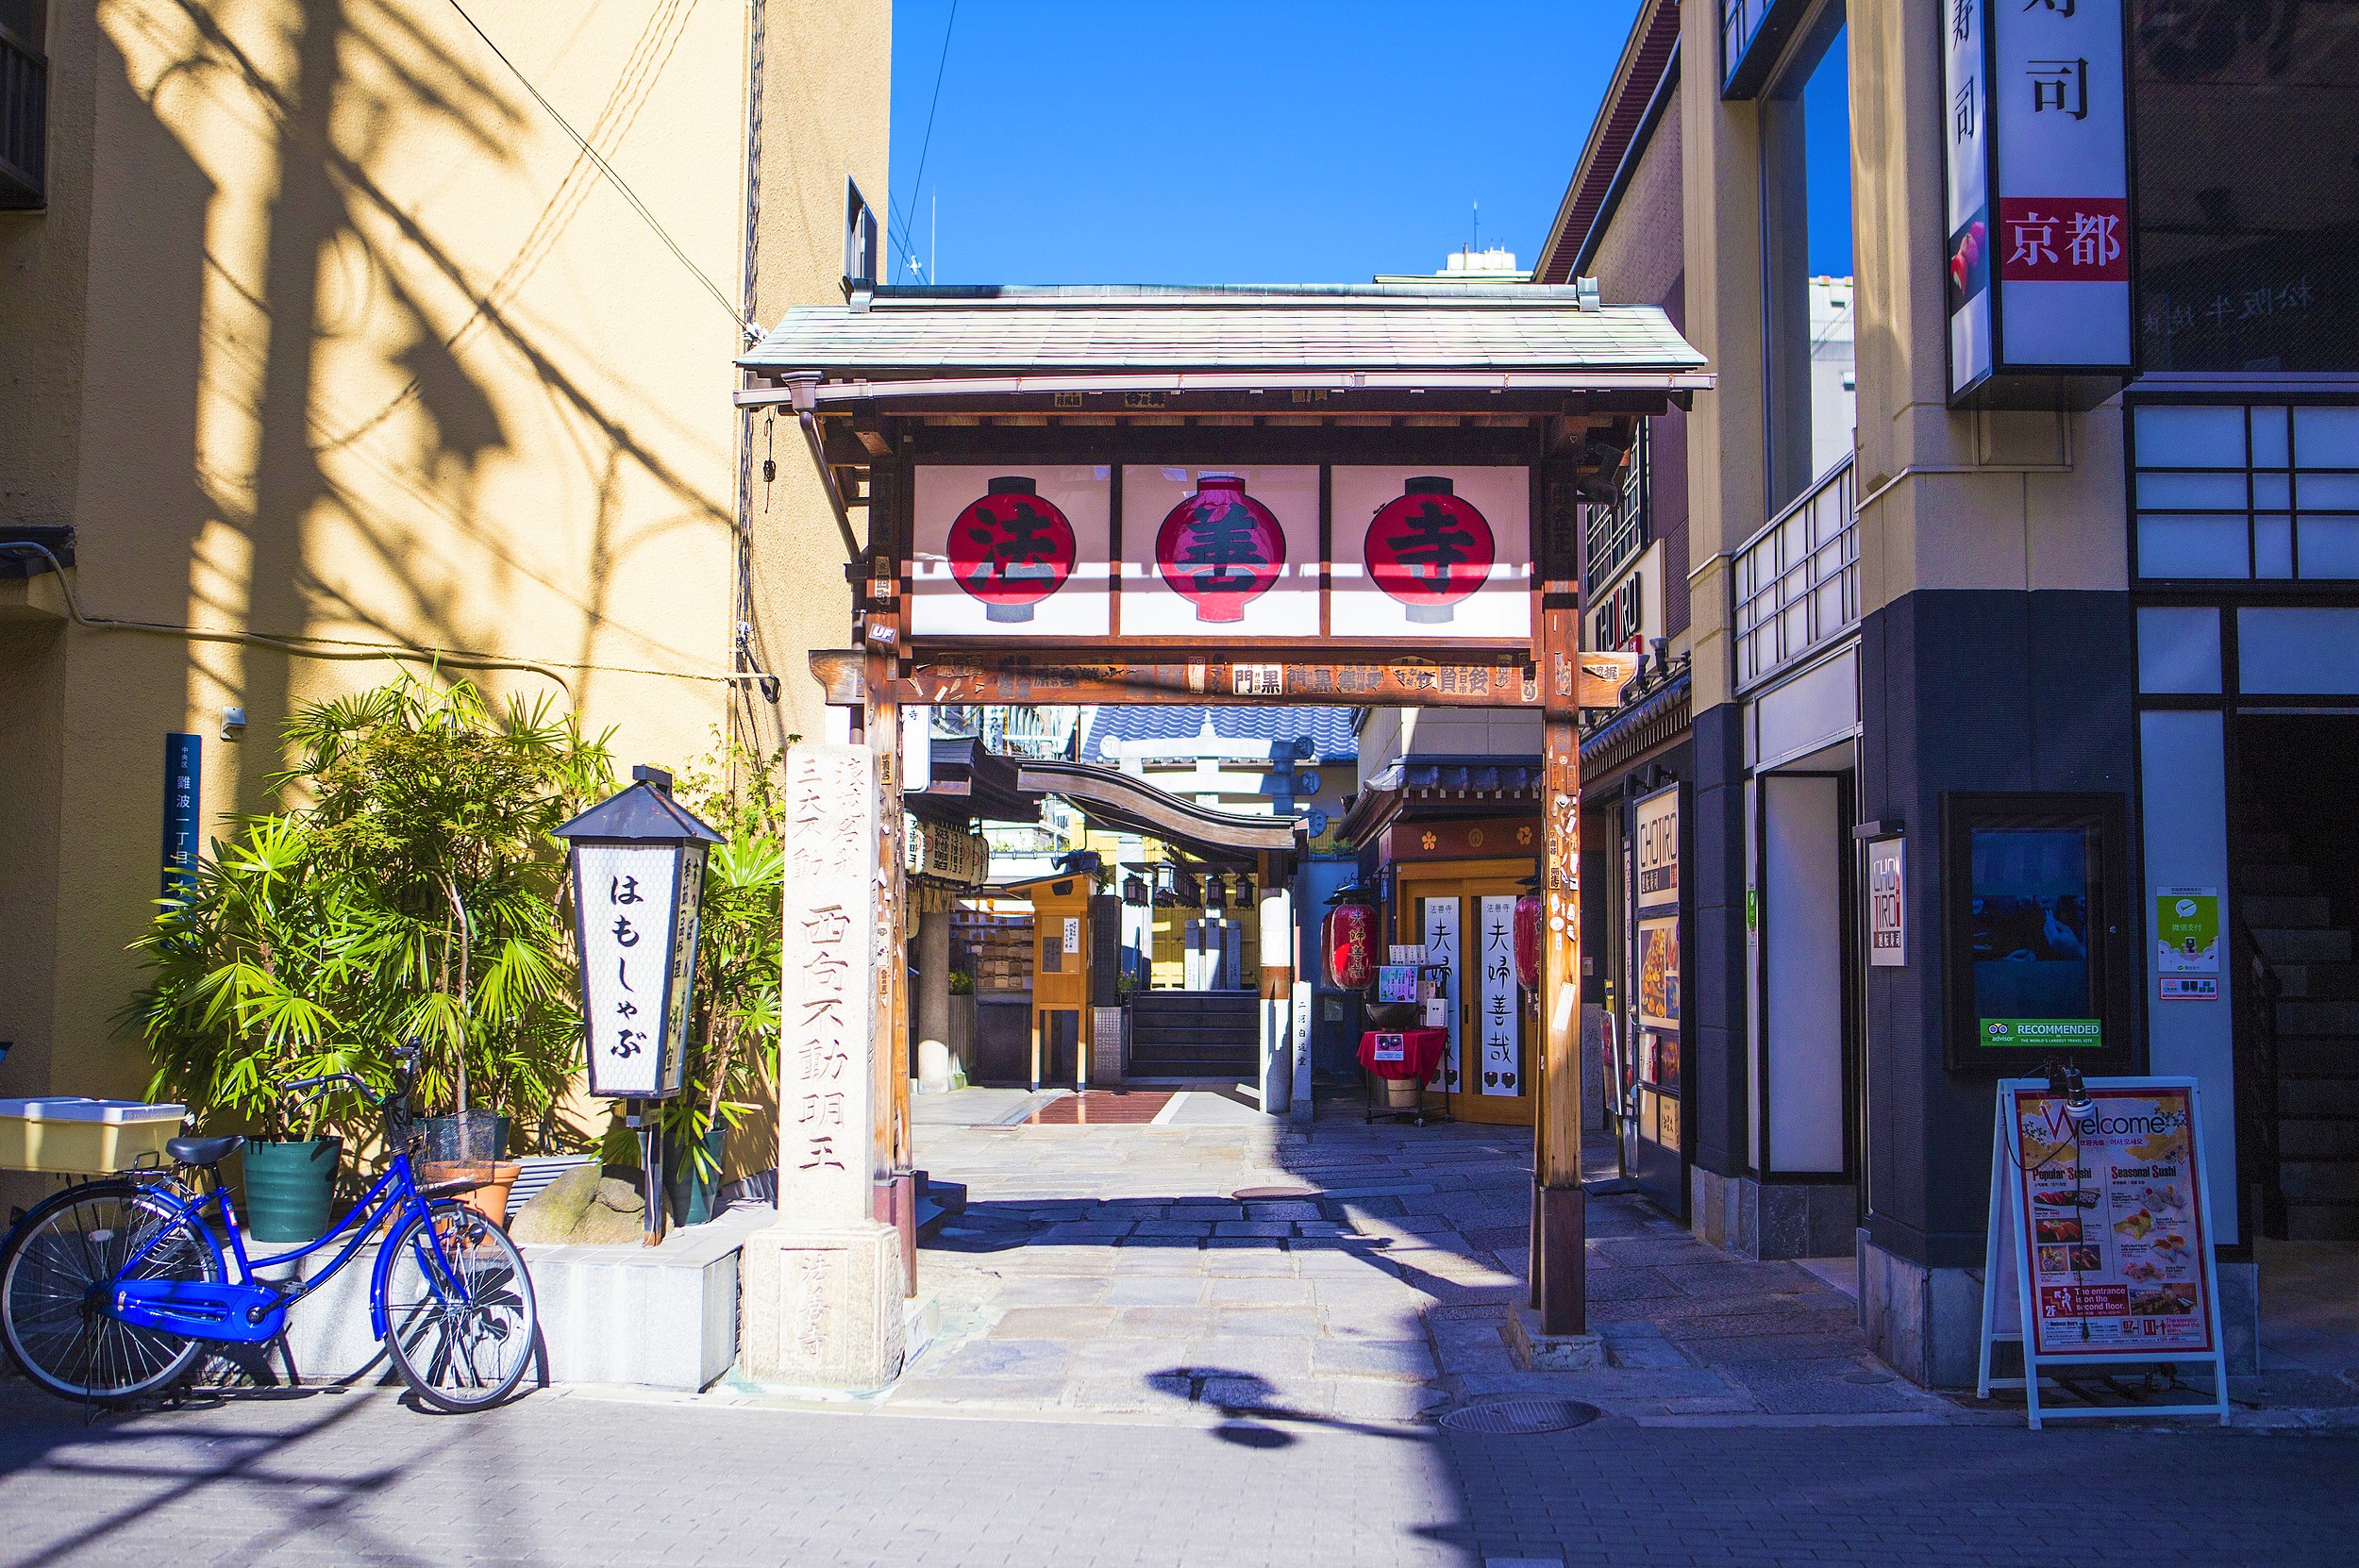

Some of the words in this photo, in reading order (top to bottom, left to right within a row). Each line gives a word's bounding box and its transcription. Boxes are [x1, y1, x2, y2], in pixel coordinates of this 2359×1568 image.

[2006, 212, 2120, 266] 京都
[874, 626, 895, 639] UF
[1874, 857, 1896, 892] CHO
[1430, 904, 1452, 914] 法善寺
[1486, 903, 1510, 913] 法善寺
[2171, 924, 2201, 932] 微信支付
[1347, 910, 1367, 979] 夫婦善哉
[610, 875, 647, 1059] はもしゃぶ
[1486, 919, 1513, 1065] 夫婦善哉
[2017, 1025, 2100, 1034] RECOMMENDED
[797, 904, 850, 1171] 西向不動明王
[2040, 1105, 2166, 1141] Welcome
[2033, 1168, 2066, 1181] Popular
[2111, 1166, 2150, 1178] Seasonal
[2152, 1165, 2177, 1178] Sushi
[798, 1253, 831, 1359] 法善寺
[2046, 1306, 2057, 1317] 2F
[2077, 1303, 2104, 1311] second
[2104, 1302, 2125, 1310] floor.
[2123, 1320, 2133, 1329] 67
